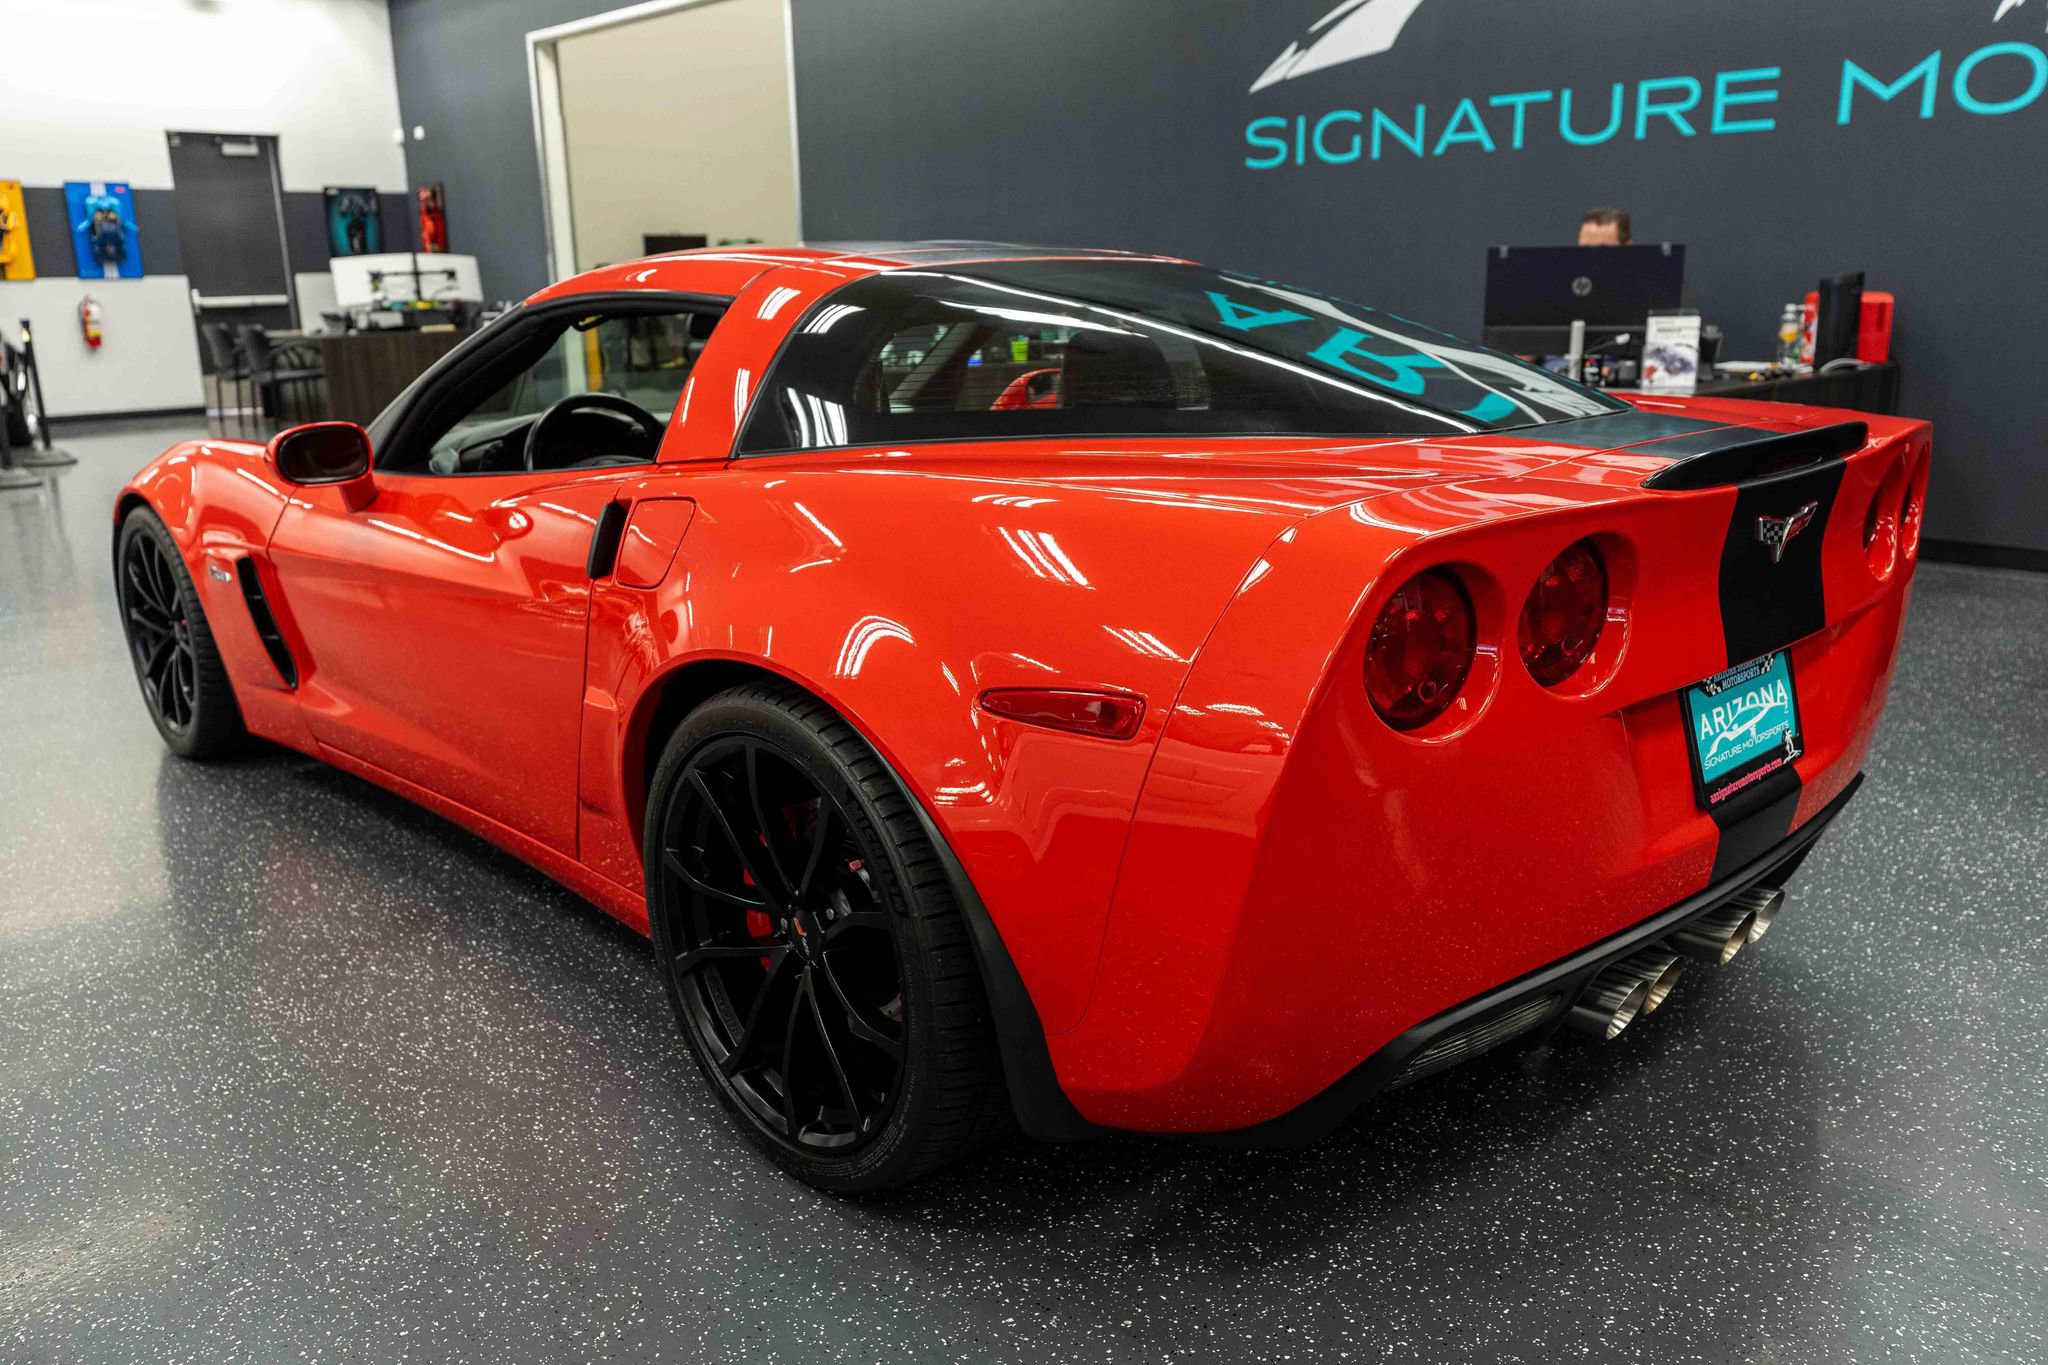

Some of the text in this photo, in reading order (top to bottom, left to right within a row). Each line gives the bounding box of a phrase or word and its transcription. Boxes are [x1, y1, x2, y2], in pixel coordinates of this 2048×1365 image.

[1244, 41, 2048, 169] SIGNATURE MO
[1722, 667, 1760, 690] MOTORSPORTS
[1700, 680, 1788, 740] ARIZONA
[1703, 720, 1789, 770] SIGNATURE MOTORSPORTS
